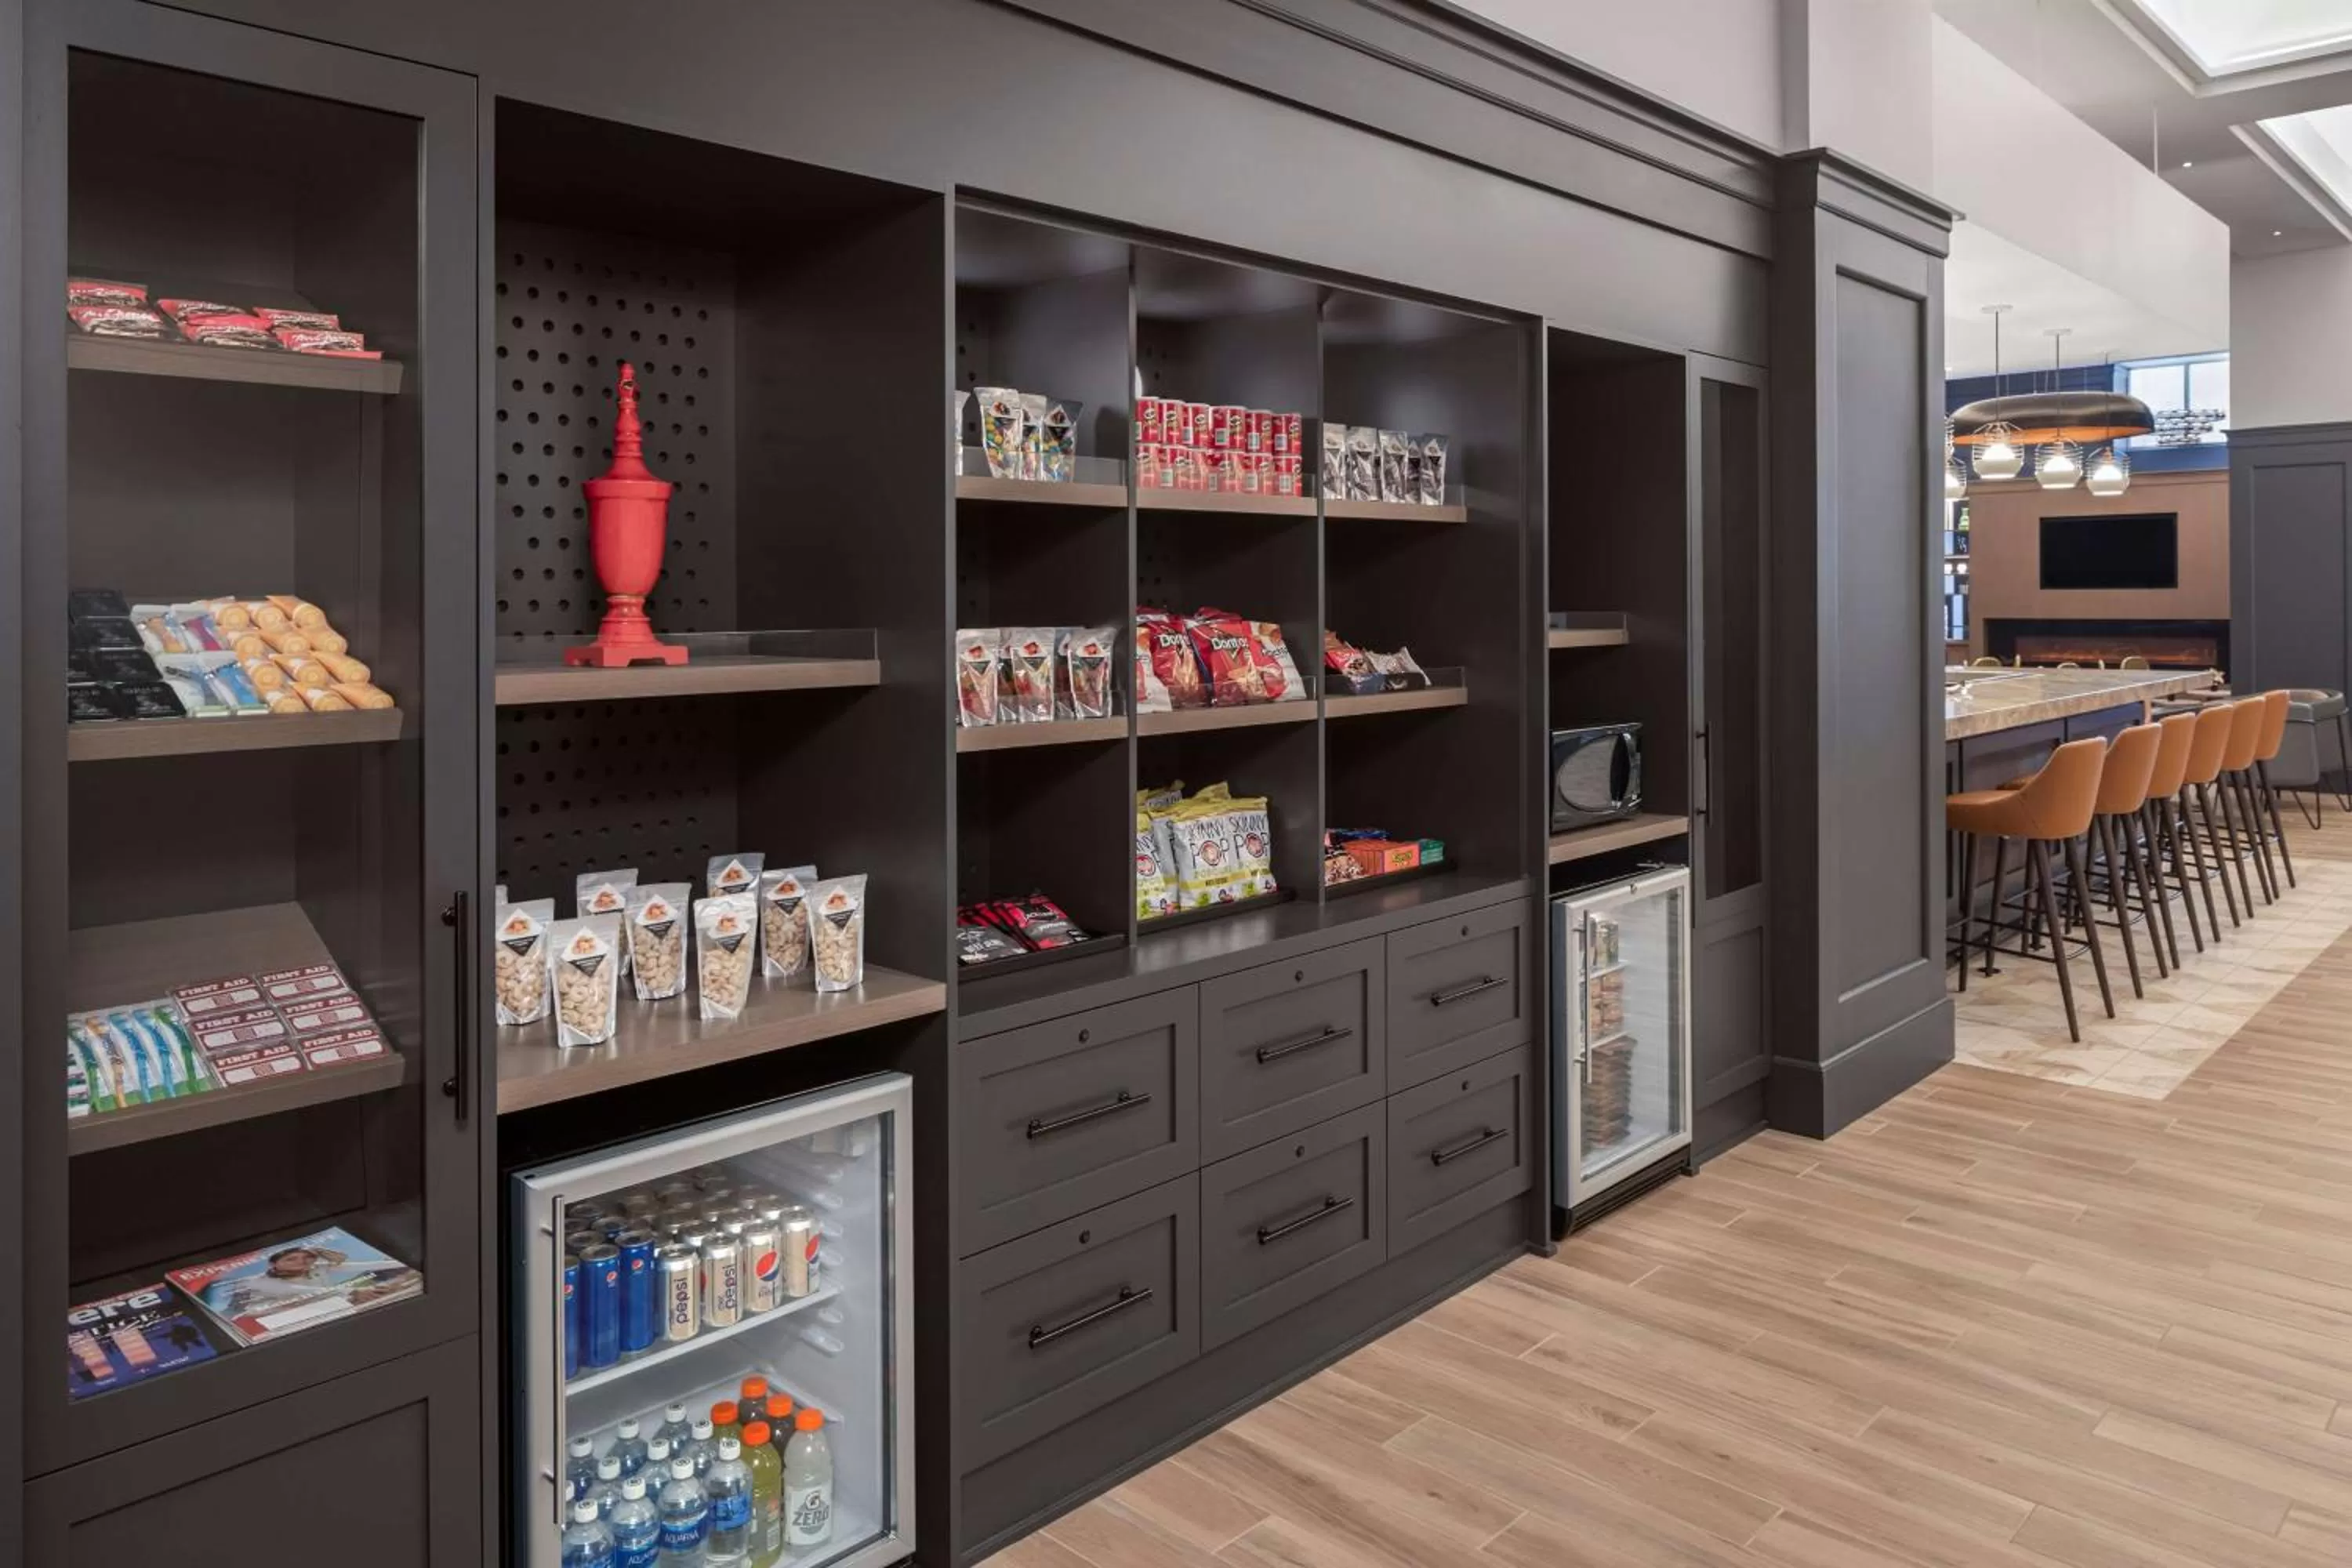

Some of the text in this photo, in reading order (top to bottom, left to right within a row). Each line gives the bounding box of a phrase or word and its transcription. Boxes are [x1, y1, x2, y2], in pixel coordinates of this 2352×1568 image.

[1211, 637, 1249, 650] Doritos
[263, 965, 328, 982] FIRST AID
[178, 978, 249, 996] FIRST AID
[285, 996, 354, 1014] FIRST AID
[195, 1009, 274, 1029] FIRST AID
[304, 1029, 373, 1047] FIRST AID
[216, 1045, 290, 1065] FIRST AID
[723, 1265, 737, 1309] pepsi
[674, 1277, 691, 1324] pepsi
[792, 1504, 829, 1526] ZERO
